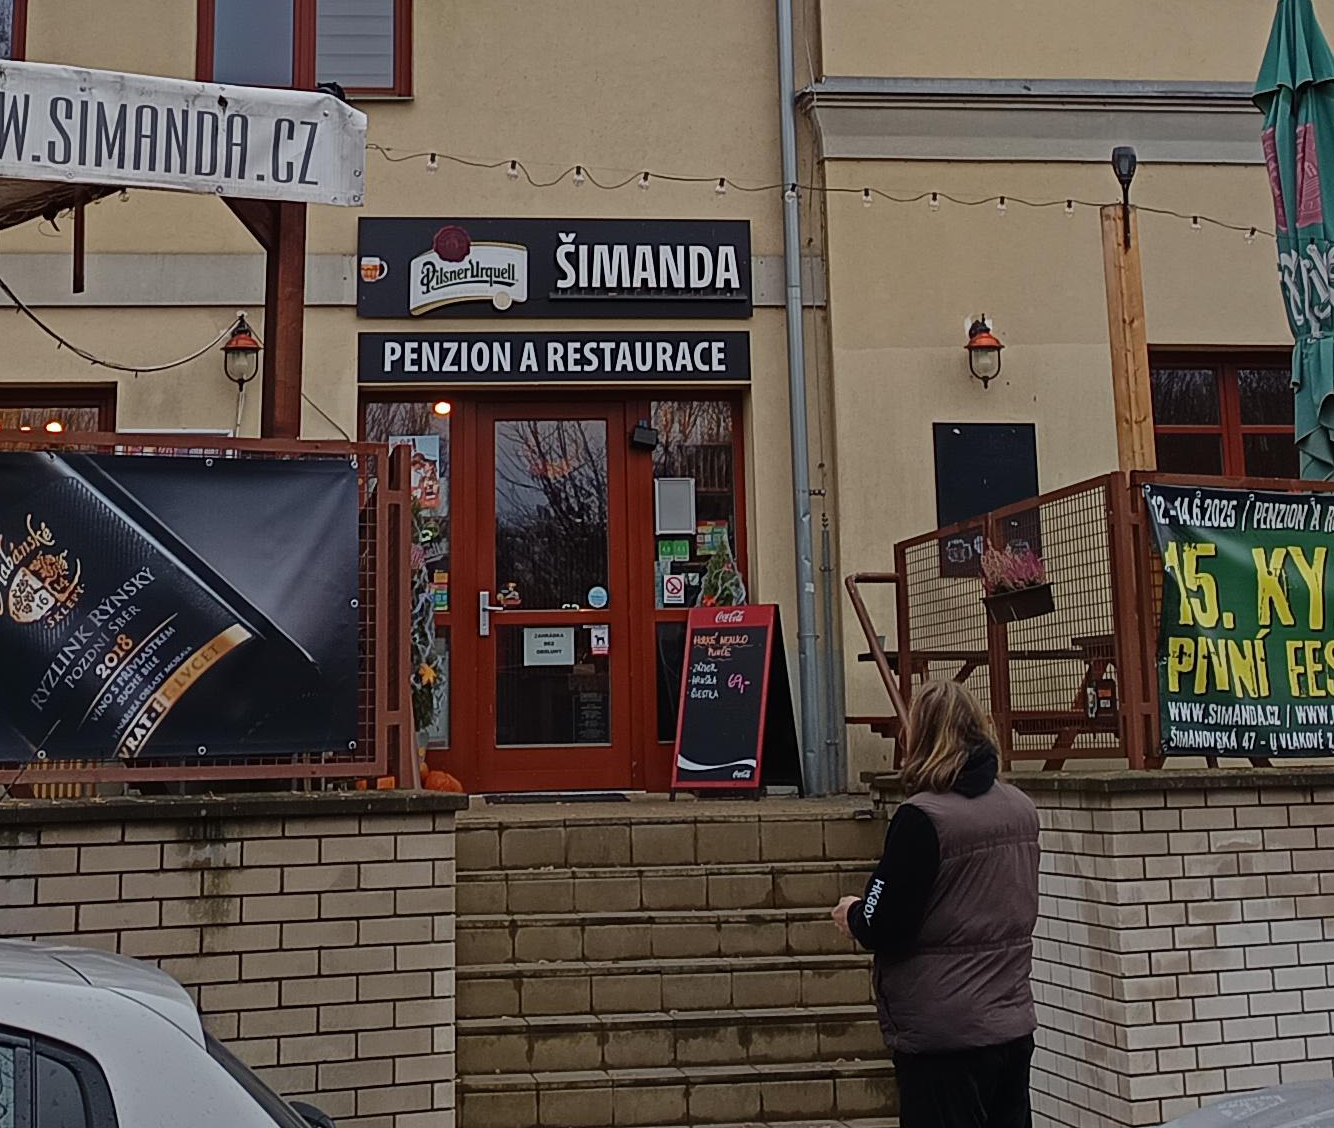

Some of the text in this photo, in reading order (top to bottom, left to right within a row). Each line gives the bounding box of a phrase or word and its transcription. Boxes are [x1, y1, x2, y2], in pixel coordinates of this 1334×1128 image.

[420, 259, 515, 295] Pilsner Urquell
[555, 232, 741, 290] ŠIMANDA
[383, 341, 727, 373] PENZION A RESTAURACE
[1253, 501, 1309, 531] PENZION
[1165, 540, 1235, 630] 15.
[31, 566, 156, 711] RYZLINK RÝNSKÝ
[64, 631, 112, 689] POZDNÍ
[95, 633, 134, 679] 2018
[1168, 629, 1271, 699] PIVNÍ
[1167, 701, 1282, 726] WWW.SIMANDA.CZ
[1169, 726, 1238, 750] ŠIMANOVSKÁ
[1242, 731, 1256, 750] 47
[1279, 729, 1324, 750] VLAKOVÉ
